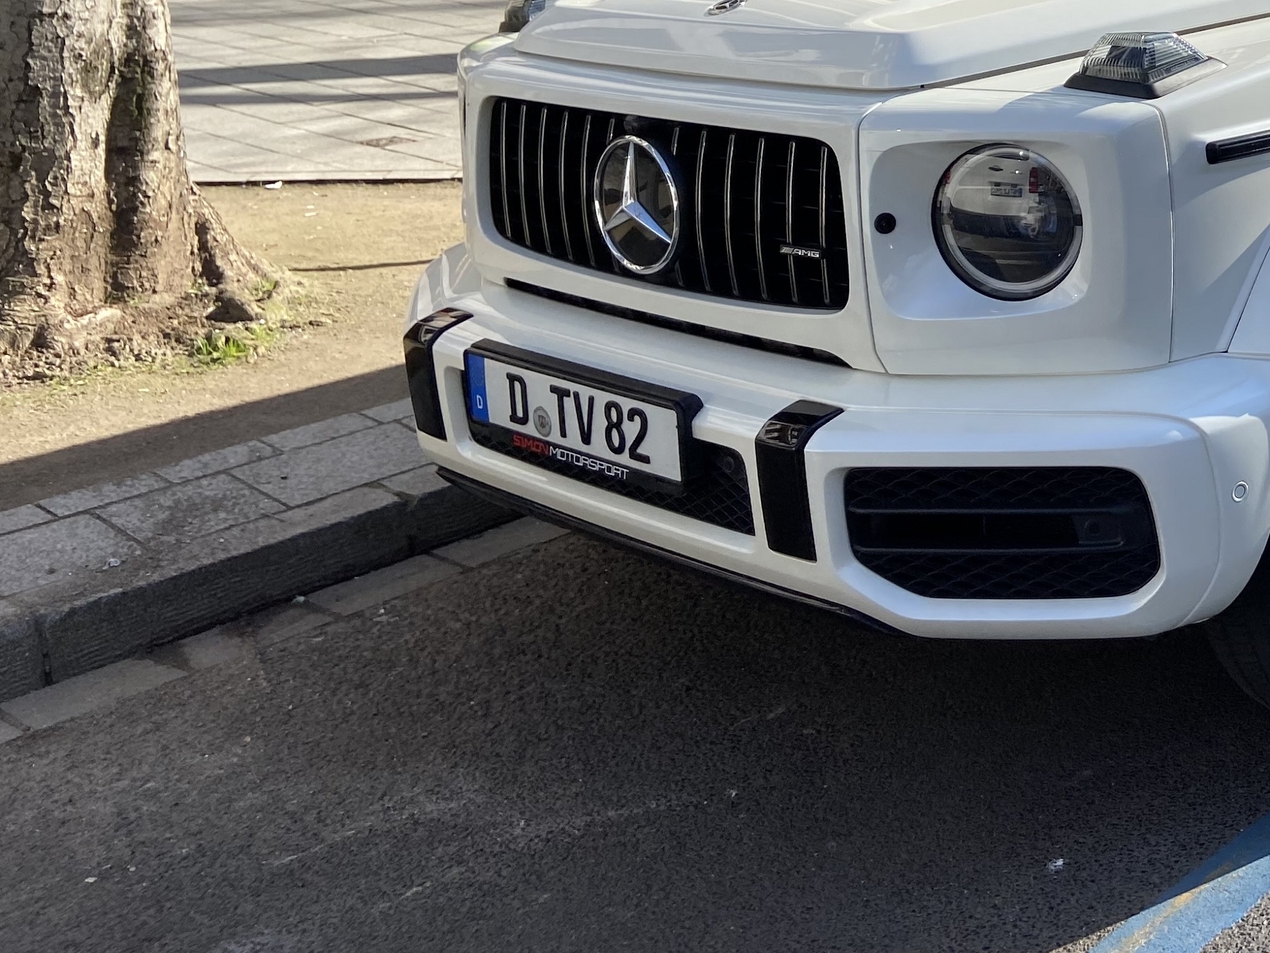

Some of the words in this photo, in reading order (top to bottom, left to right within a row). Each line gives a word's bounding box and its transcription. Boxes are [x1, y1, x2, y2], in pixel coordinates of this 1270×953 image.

[791, 248, 820, 258] AMG
[476, 394, 483, 409] D
[506, 372, 529, 426] D
[549, 384, 595, 446] TV
[604, 400, 651, 465] 82
[513, 434, 549, 456] SIMON
[549, 446, 630, 480] MOTORSPORT
